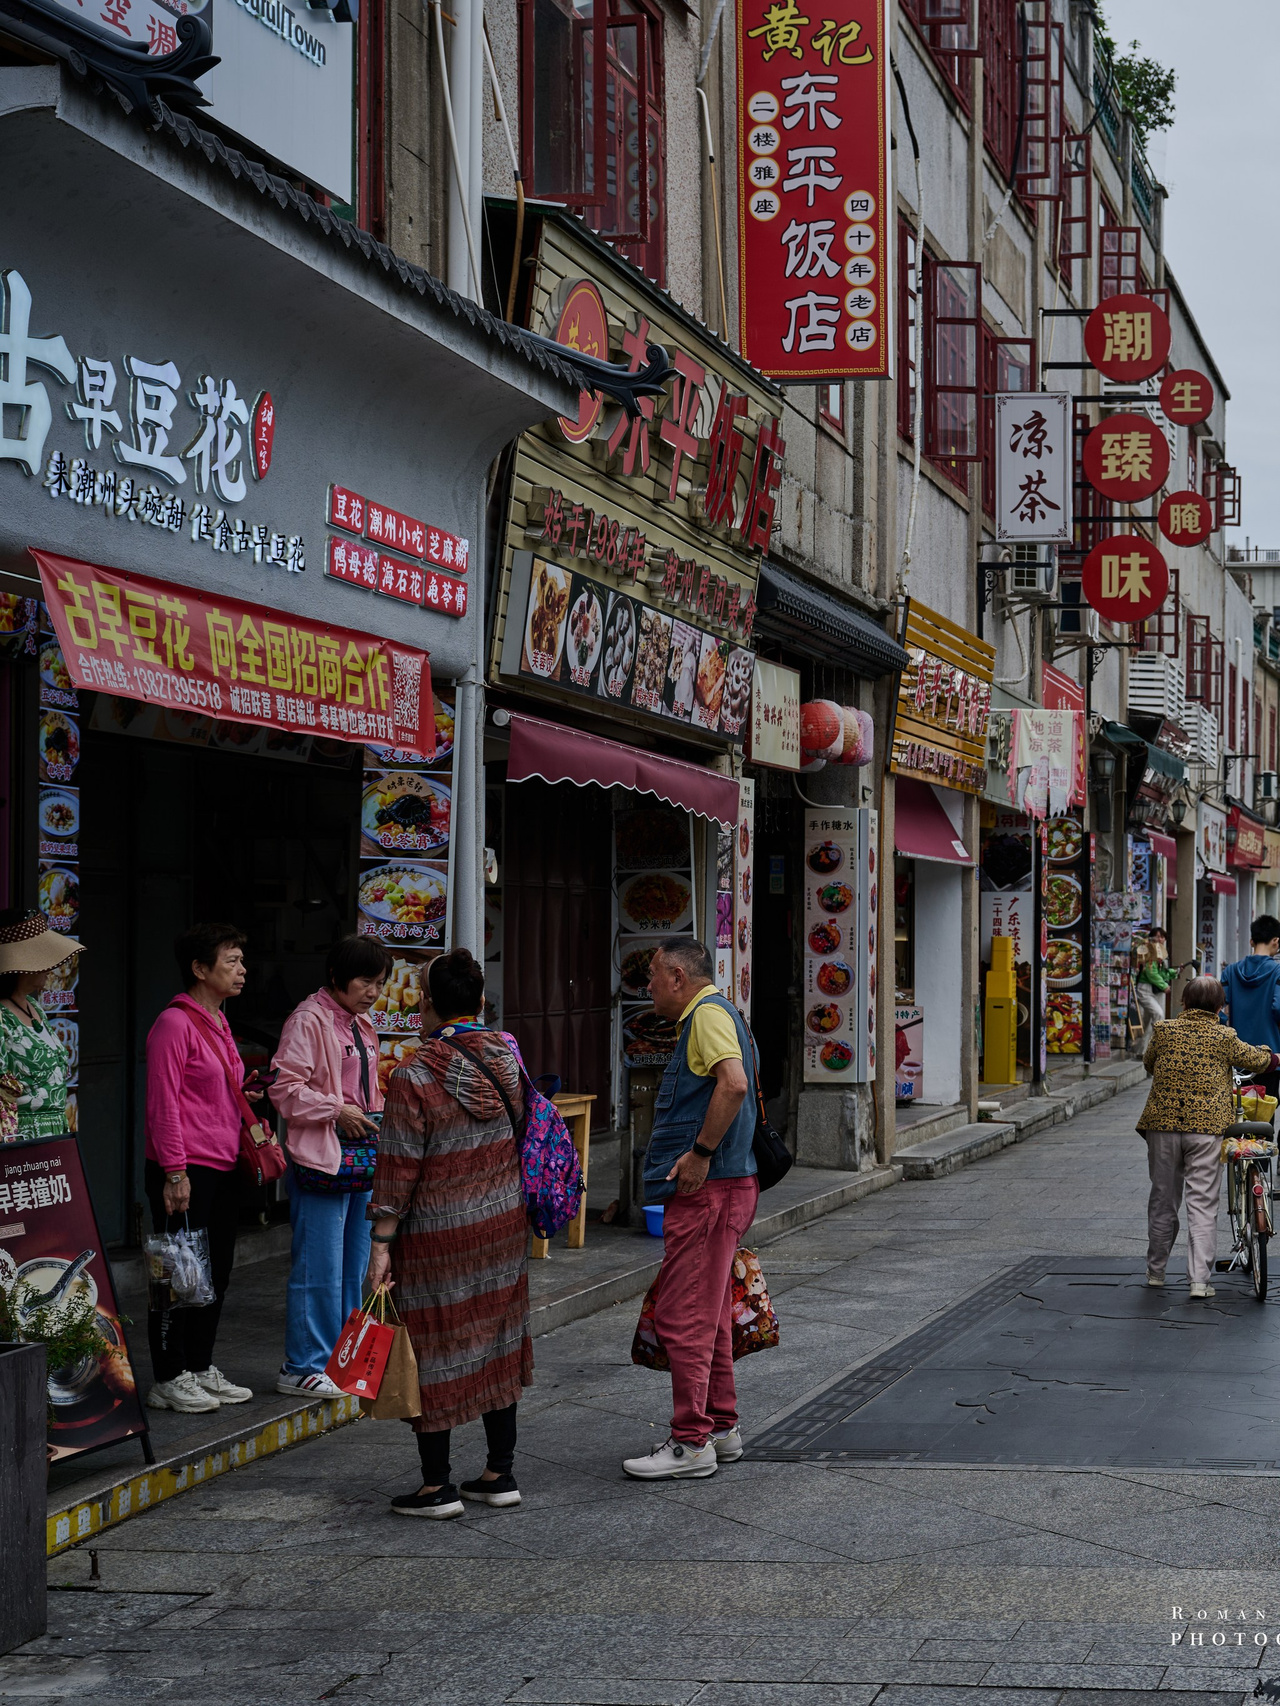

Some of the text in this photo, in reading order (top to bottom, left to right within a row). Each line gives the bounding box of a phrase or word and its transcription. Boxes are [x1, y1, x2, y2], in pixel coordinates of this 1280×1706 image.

[748, 0, 873, 66] 黄记
[752, 99, 776, 214] 二楼雅座
[780, 71, 843, 354] 东平饭店
[849, 198, 872, 343] 四十年老店
[0, 268, 248, 503] 古早豆花
[607, 313, 786, 557] 东平饭店
[1009, 410, 1061, 524] 凉茶
[335, 494, 362, 528] 豆花
[370, 508, 423, 553] 潮州小吃
[382, 561, 421, 599] 海石花
[427, 576, 466, 612] 龟苓膏
[541, 487, 757, 638] 始于1984年 潮州民间美食
[57, 572, 391, 711] 古早豆花 向全国招商合作
[229, 687, 271, 718] 诚招联营
[276, 696, 316, 727] 整店输出
[380, 833, 431, 849] 龟苓膏
[809, 820, 853, 831] 手作糖水
[364, 923, 440, 939] 五谷清心丸
[639, 919, 671, 930] 炒米粉
[993, 898, 1002, 936] 二十四味
[373, 1012, 422, 1027] 菜头粿
[0, 1174, 72, 1215] 早姜撞奶
[4, 1156, 62, 1178] jiang zhuang nai
